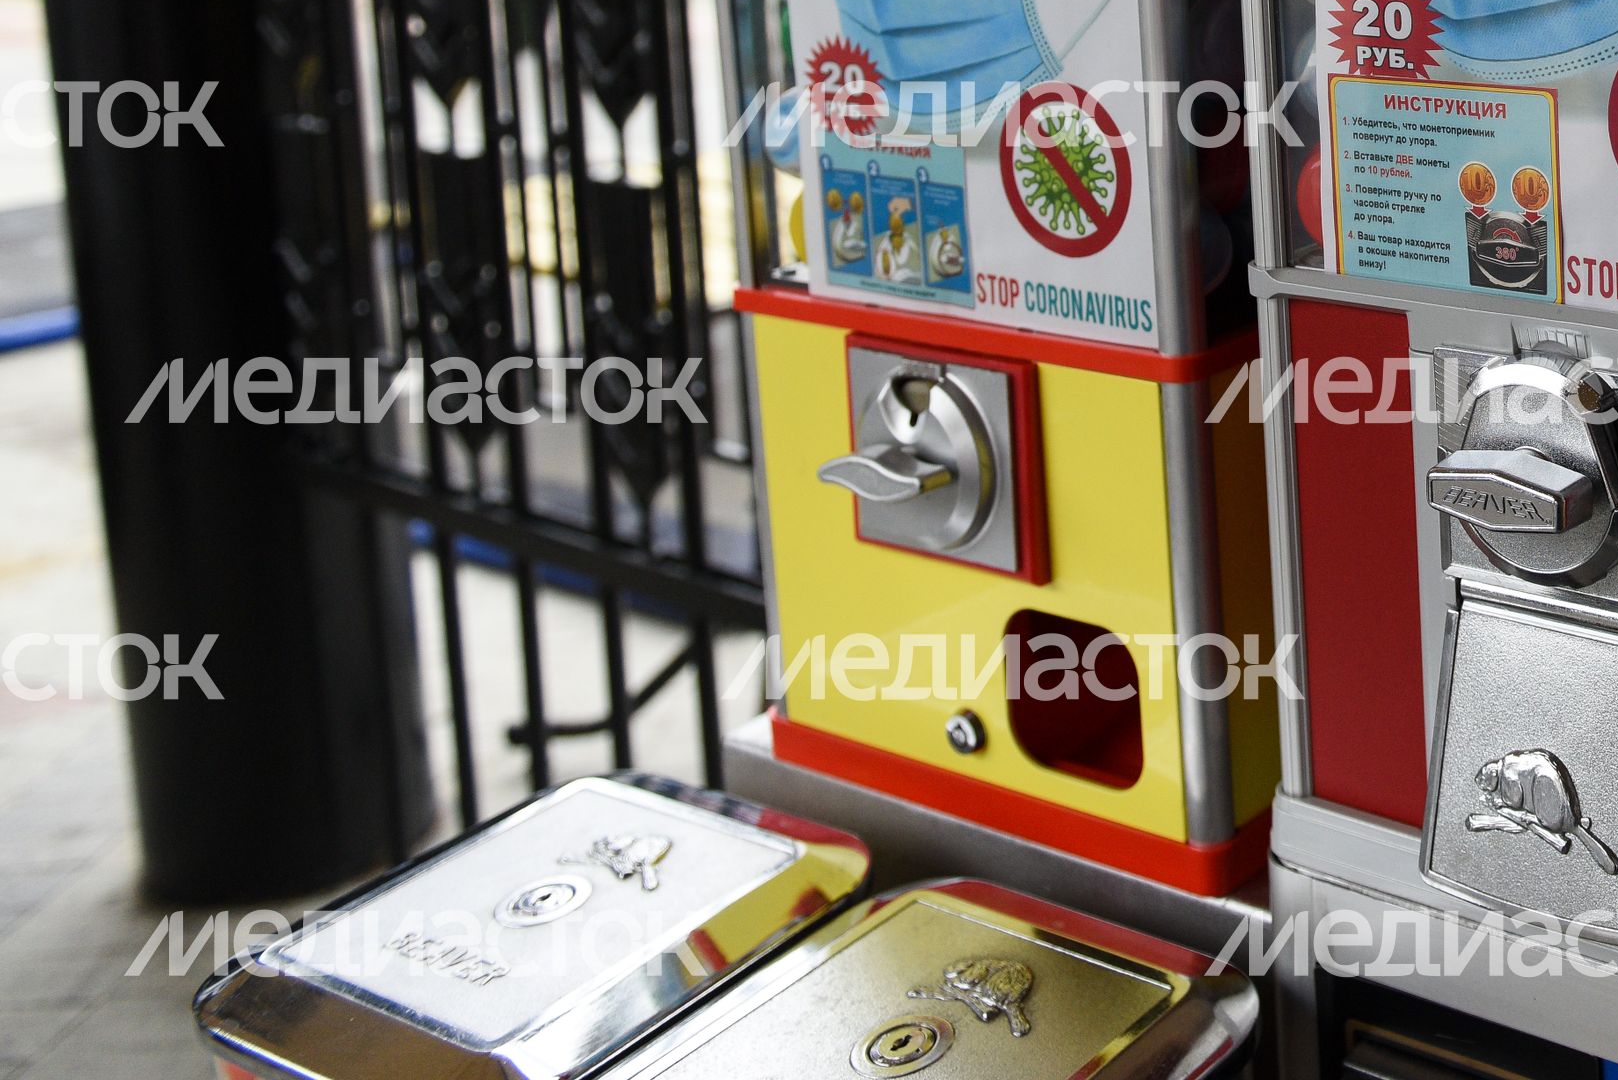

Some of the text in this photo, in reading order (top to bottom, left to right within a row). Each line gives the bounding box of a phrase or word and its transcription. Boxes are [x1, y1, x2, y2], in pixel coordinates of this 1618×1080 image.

[1355, 46, 1415, 72] РУБ.
[820, 61, 865, 96] 20
[1384, 94, 1507, 120] ИНСТРУКЦИЯ
[1343, 117, 1496, 138] 1. Убедитесь, что монетоприемник
[1353, 133, 1437, 147] повернут до упора.
[1344, 151, 1450, 169] 2. Вставьте ДВЕ монеты
[1354, 166, 1412, 179] по 10 рублей.
[1346, 184, 1442, 203] 3. Поверните ручку по
[1353, 198, 1426, 215] часовой стрелке
[1354, 213, 1394, 225] до упора.
[1348, 231, 1451, 251] 4. Ваш товар находится
[1358, 246, 1450, 264] в окошке накопителя
[1358, 258, 1387, 270] внизу!
[977, 272, 1153, 333] STOP CORONAVIRUS
[1444, 485, 1545, 522] BEAVER
[382, 932, 511, 986] BEAVER
